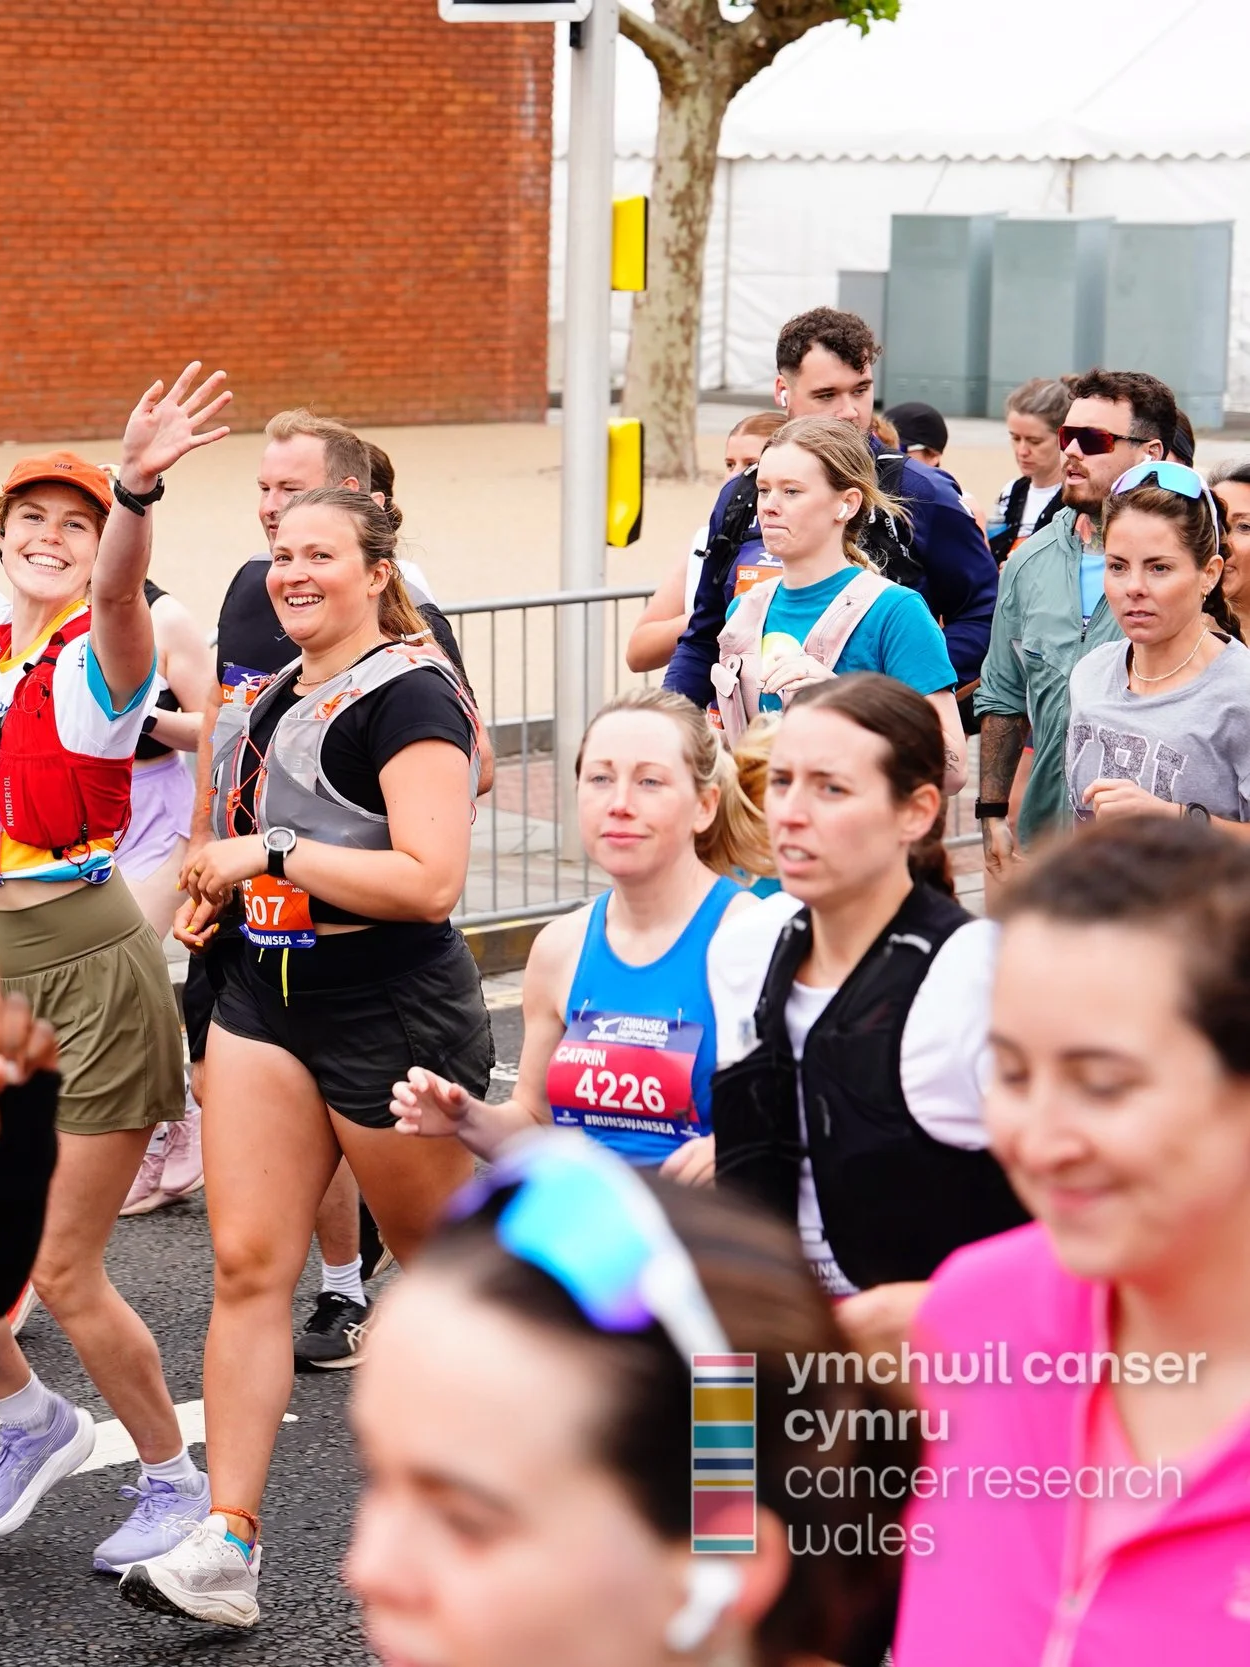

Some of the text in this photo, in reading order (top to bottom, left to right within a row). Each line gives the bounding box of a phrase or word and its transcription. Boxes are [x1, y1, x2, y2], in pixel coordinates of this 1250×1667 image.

[739, 569, 758, 580] BEN
[622, 1016, 669, 1034] SWANSEA
[555, 1046, 607, 1068] CATRIN
[575, 1067, 666, 1114] 4226
[584, 1114, 676, 1136] #RUNSWANSEA
